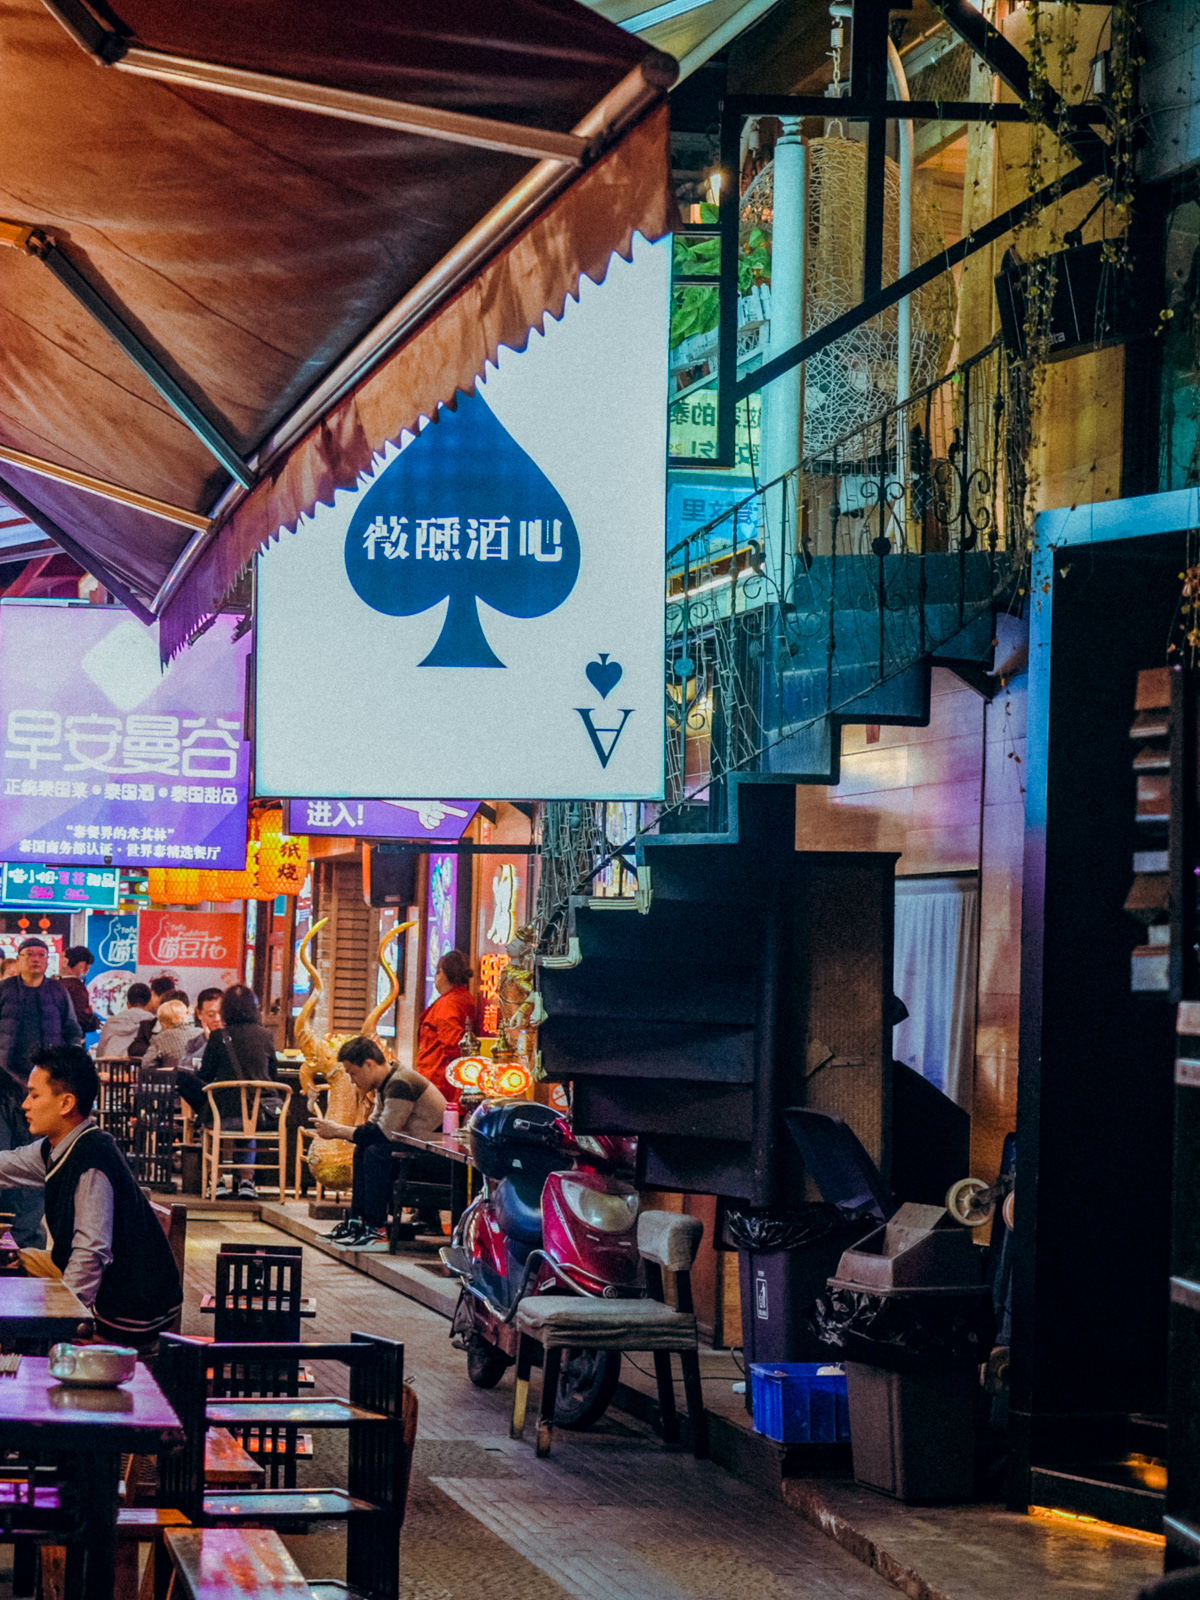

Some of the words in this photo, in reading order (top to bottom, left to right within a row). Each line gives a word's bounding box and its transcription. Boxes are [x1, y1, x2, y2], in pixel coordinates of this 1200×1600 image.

[363, 515, 562, 562] 微醺酒吧
[4, 709, 241, 779] 早安曼谷
[573, 708, 636, 769] A
